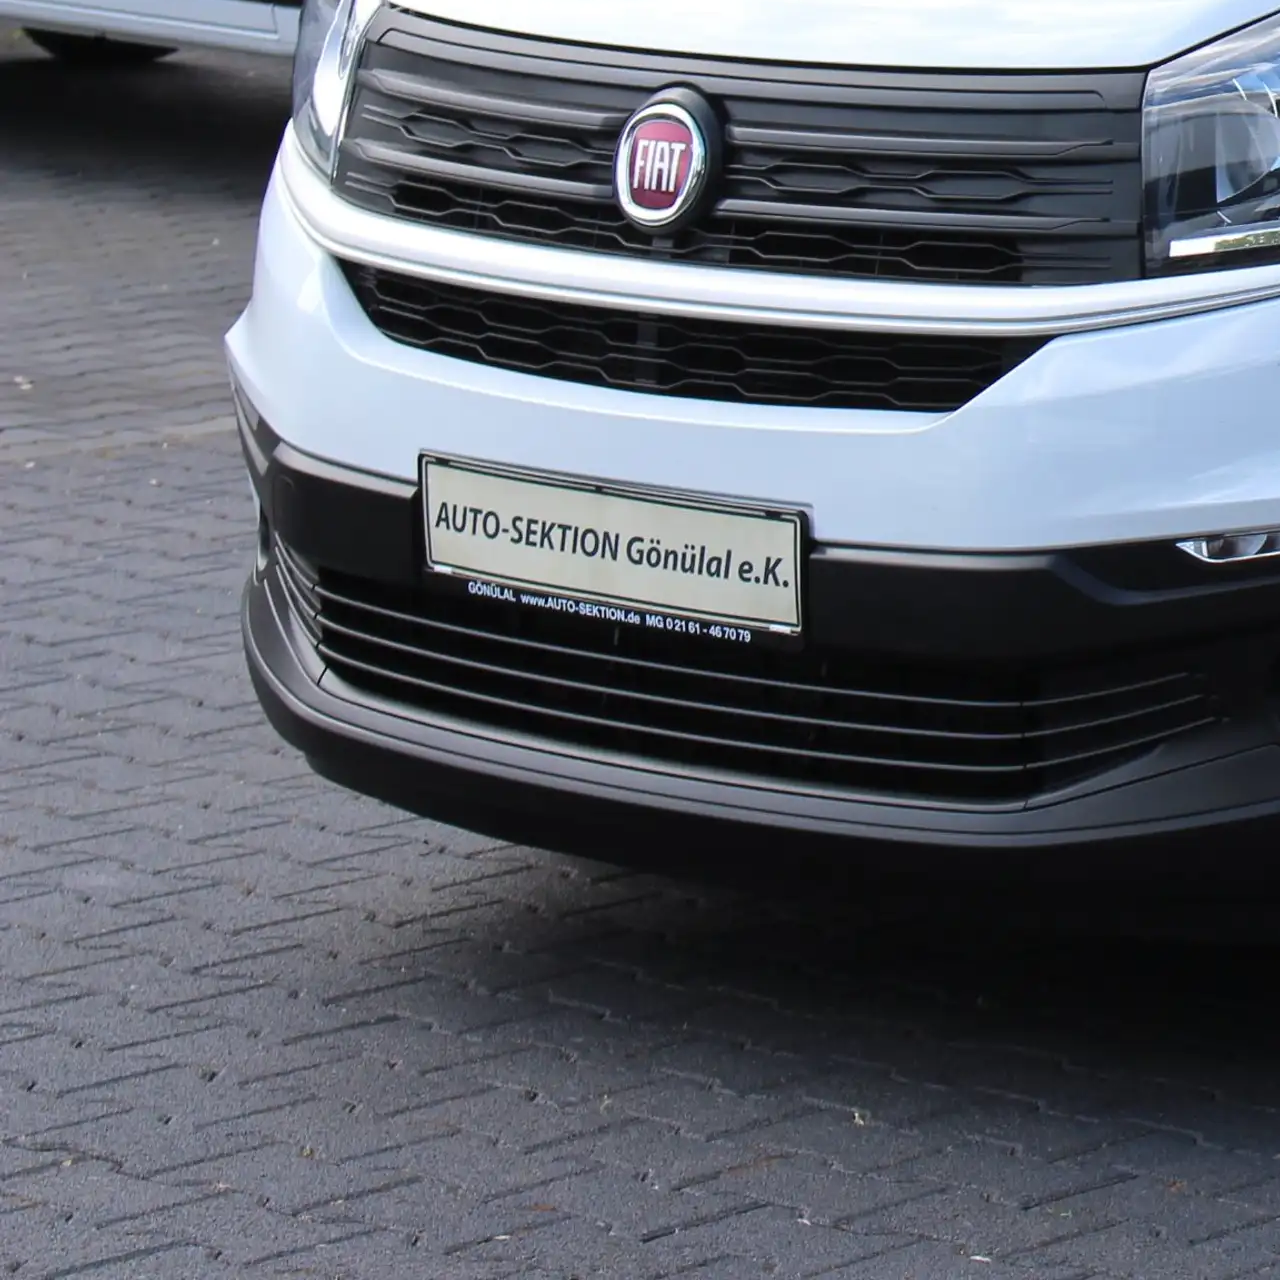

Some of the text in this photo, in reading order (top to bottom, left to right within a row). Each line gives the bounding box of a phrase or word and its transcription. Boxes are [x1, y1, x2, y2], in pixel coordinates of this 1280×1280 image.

[633, 138, 686, 193] FIAT
[435, 501, 790, 588] AUTO-SEKTION Gönülal e.K.
[467, 580, 516, 603] GÖNÜLAL
[520, 593, 641, 625] www.AUTO-SEKTION.de
[645, 614, 664, 629] MG
